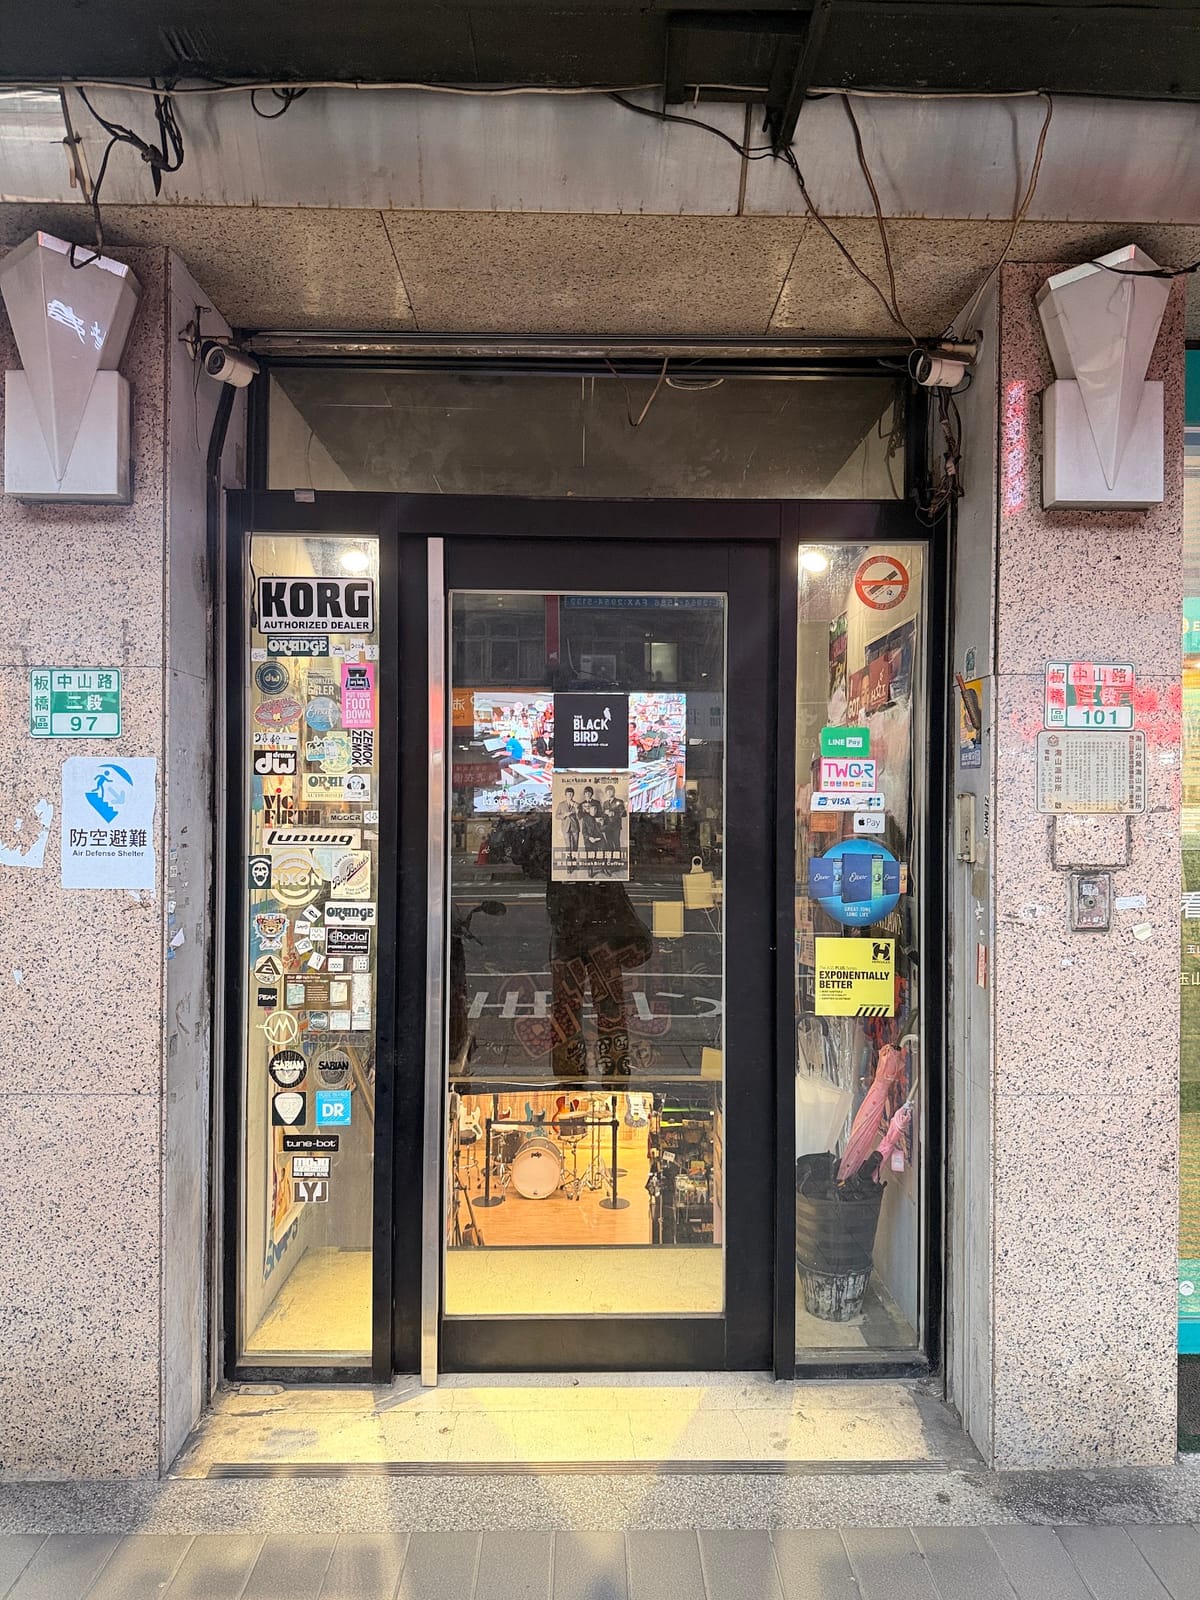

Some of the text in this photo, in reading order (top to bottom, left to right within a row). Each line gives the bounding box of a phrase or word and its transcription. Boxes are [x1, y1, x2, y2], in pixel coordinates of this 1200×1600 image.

[262, 582, 370, 618] KORG
[264, 621, 369, 629] AUTHORIZED DEALER
[268, 640, 327, 656] ORANGE
[57, 673, 113, 690] 中山路
[1073, 667, 1127, 683] 中山路
[34, 675, 49, 730] 板橋區
[66, 694, 103, 711] 二段
[1050, 668, 1065, 722] 板橋區
[346, 698, 370, 709] FOOT
[346, 710, 371, 720] DOWN
[1082, 710, 1117, 725] 101
[70, 716, 98, 732] 97
[573, 719, 609, 730] BLACK
[574, 731, 598, 742] BIRD
[828, 738, 861, 747] LINE Pay
[352, 730, 362, 766] ZEMOK
[362, 730, 373, 766] ZEMOK
[255, 752, 295, 774] dw
[823, 763, 874, 778] TWQR
[264, 793, 294, 810] VIC
[832, 797, 851, 805] VISA
[265, 810, 320, 825] FIRTH
[866, 818, 881, 829] Pay
[70, 829, 148, 848] 防空避難
[326, 907, 374, 921] ORANGE
[336, 931, 368, 942] Radial
[819, 970, 890, 980] EXPONENTIALLY
[819, 980, 853, 989] BETTER
[301, 1033, 367, 1042] PROMARK
[272, 1060, 304, 1070] SABIAN
[318, 1061, 349, 1070] SABIAN
[322, 1103, 344, 1117] DR
[294, 1182, 327, 1202] LYJ
